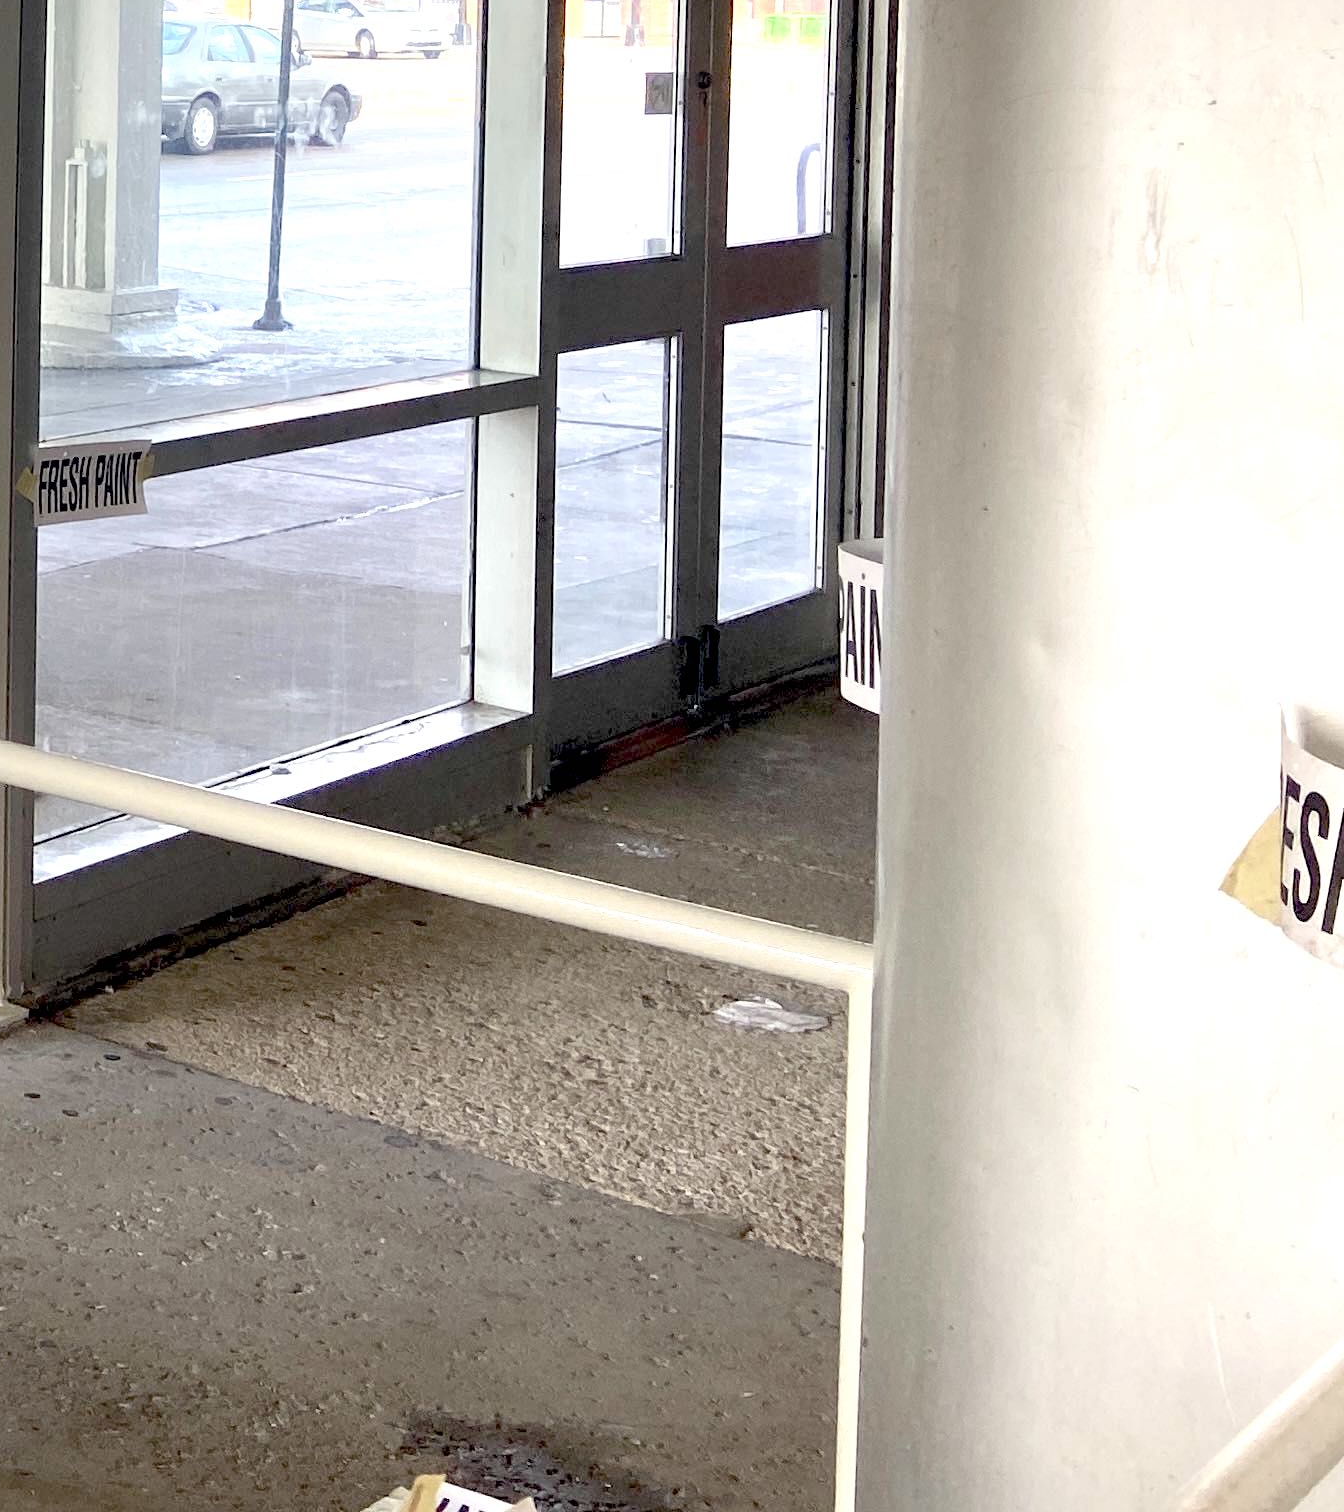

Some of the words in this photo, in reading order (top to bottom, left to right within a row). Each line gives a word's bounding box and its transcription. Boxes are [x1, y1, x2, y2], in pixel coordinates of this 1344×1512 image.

[38, 455, 92, 514] FRESH
[95, 451, 143, 508] PAINT
[838, 574, 882, 690] AIN
